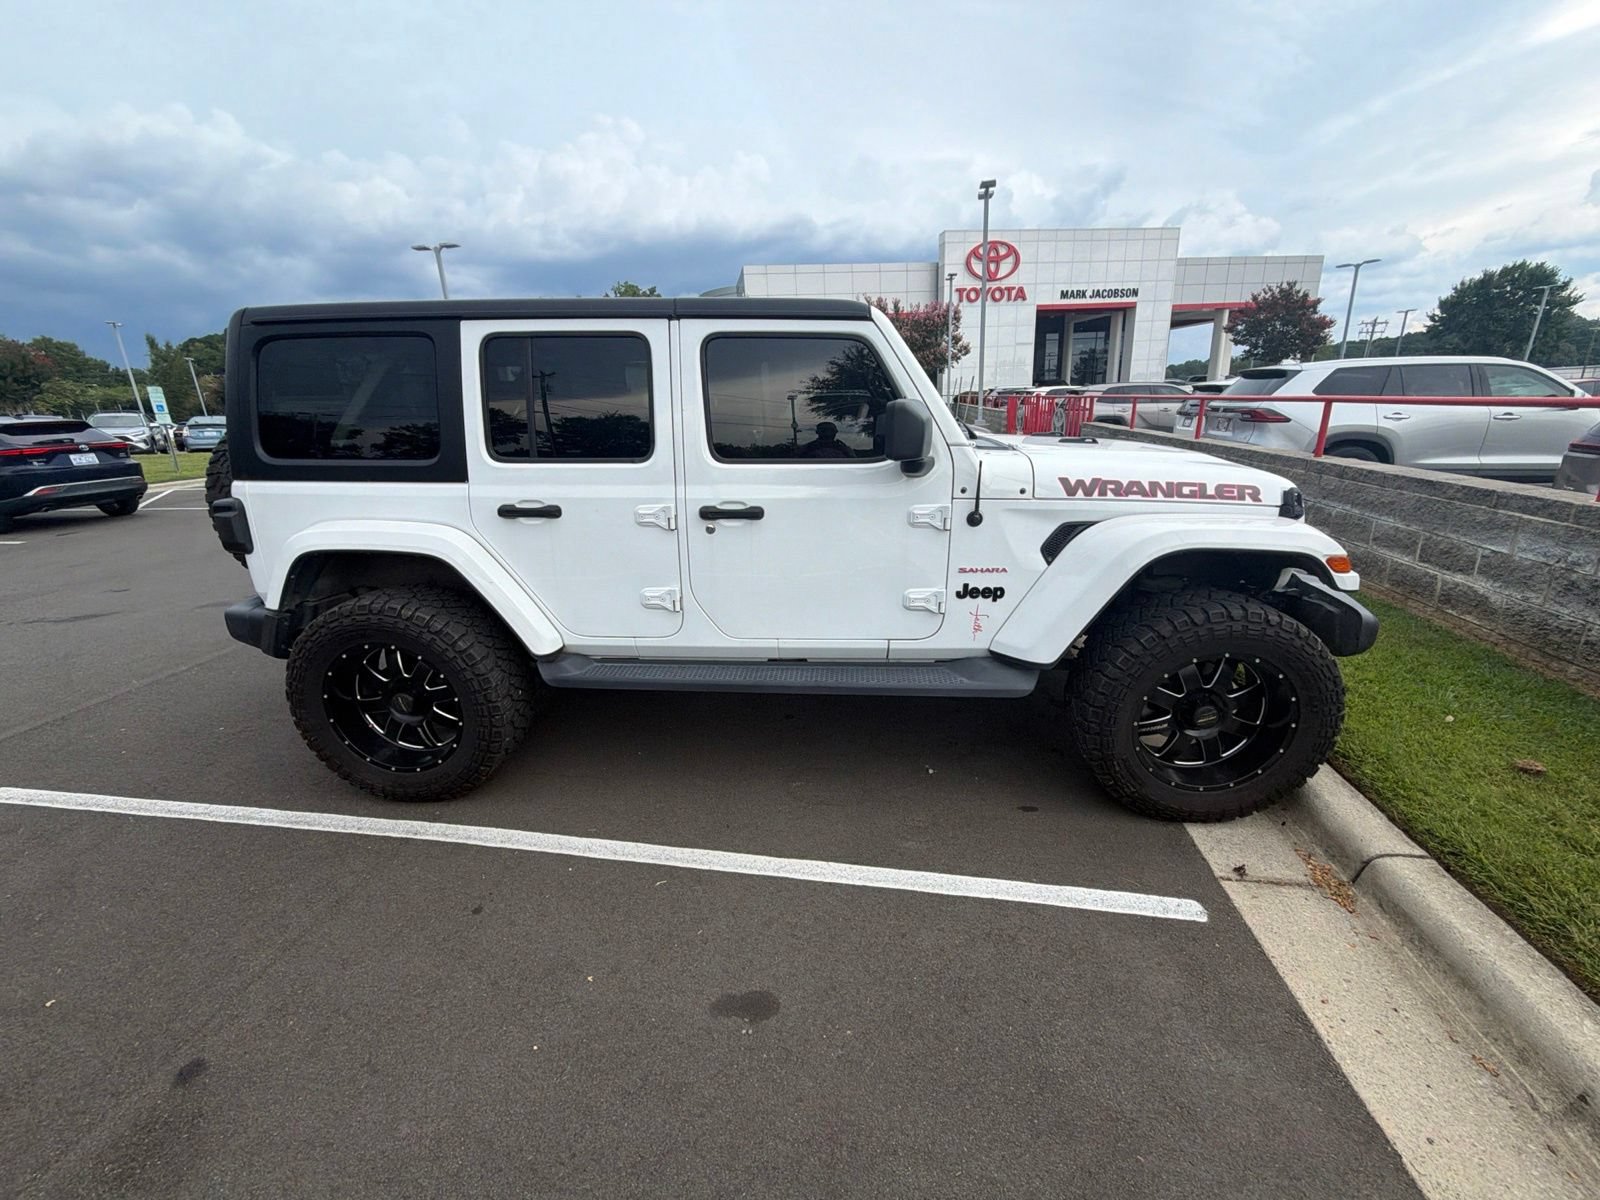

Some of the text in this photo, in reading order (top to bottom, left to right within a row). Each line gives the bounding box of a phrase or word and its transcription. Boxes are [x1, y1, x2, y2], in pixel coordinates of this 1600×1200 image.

[1060, 287, 1139, 300] MARK JACOBSON
[1058, 476, 1263, 503] WRANGLER
[955, 582, 1006, 603] Jeep
